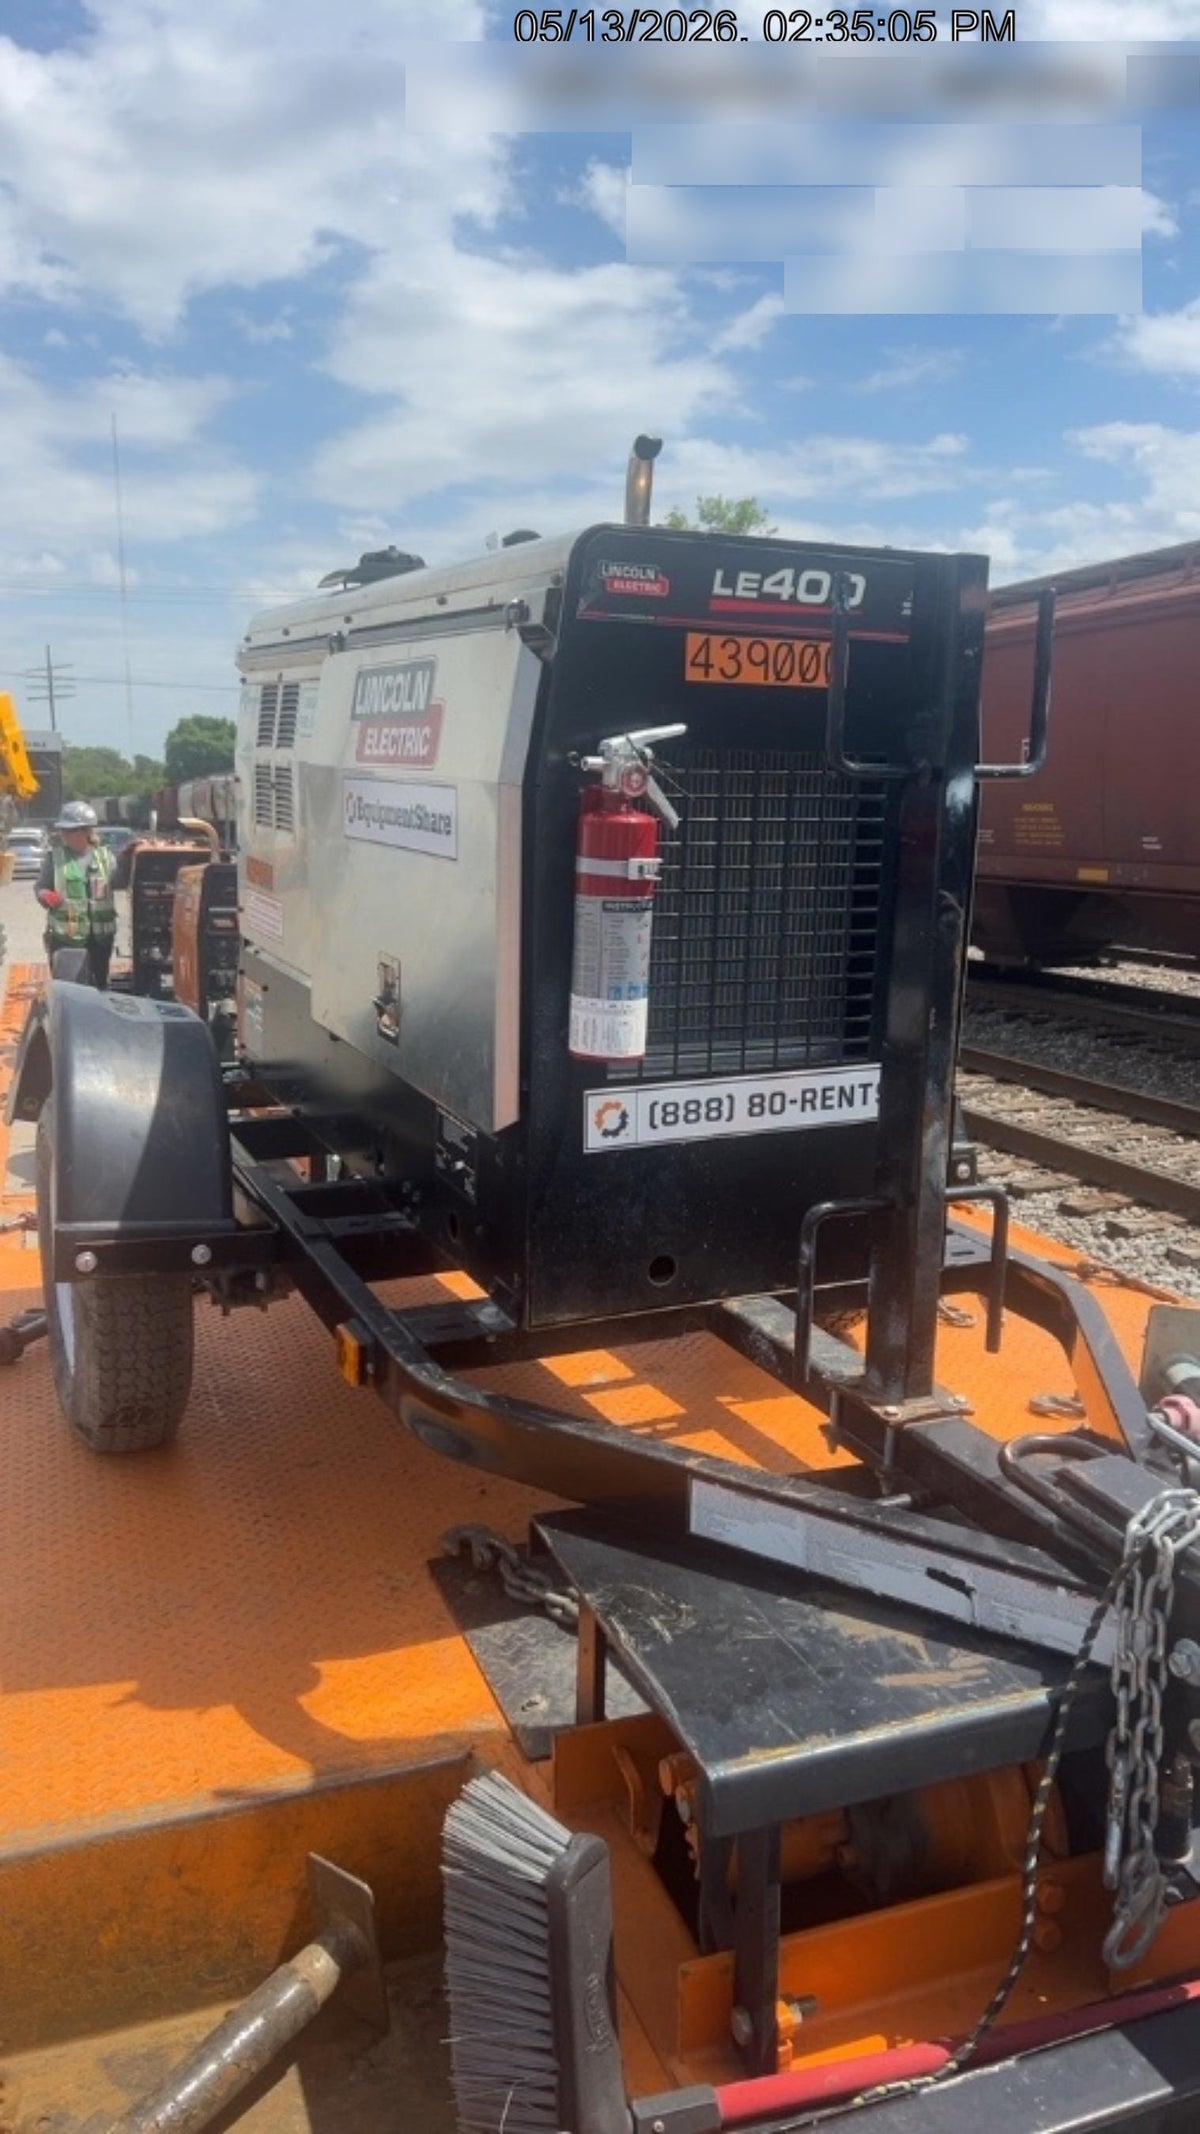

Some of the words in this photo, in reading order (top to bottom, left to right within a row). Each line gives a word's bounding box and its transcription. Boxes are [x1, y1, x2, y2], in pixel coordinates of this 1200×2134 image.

[601, 563, 656, 580] LINCOLN
[690, 637, 832, 684] 43900
[355, 670, 430, 714] LINCOLN
[364, 726, 432, 757] ELECTRIC
[357, 795, 452, 836] EquipmentShare
[649, 1094, 735, 1129] (888)
[747, 1083, 881, 1118] 80-RENT
